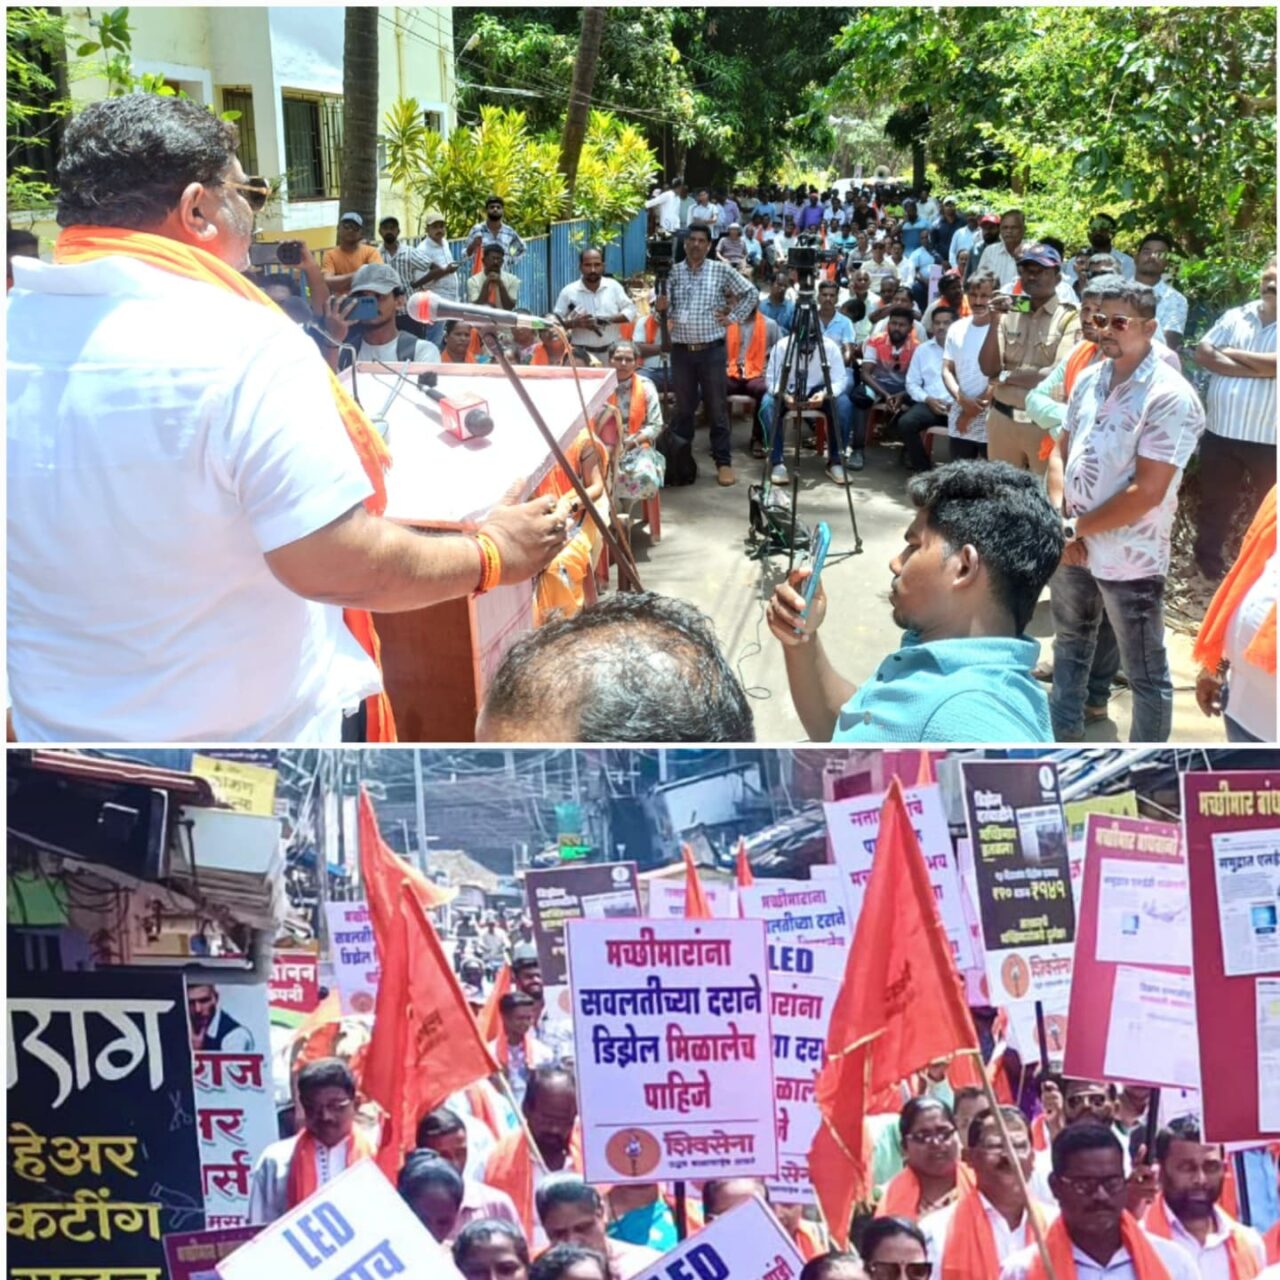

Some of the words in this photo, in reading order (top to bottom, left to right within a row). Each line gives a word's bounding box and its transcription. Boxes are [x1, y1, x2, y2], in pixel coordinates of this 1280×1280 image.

[607, 926, 731, 969] मच्छीमारांना
[768, 945, 814, 974] LED
[581, 976, 701, 1017] सवलतीच्या
[707, 973, 762, 1016] दराने
[7, 998, 176, 1109] राग
[593, 1024, 659, 1068] डिझेल
[666, 1021, 756, 1063] मिळालेच
[643, 1070, 712, 1113] पाहिजे
[8, 1133, 139, 1183] हेअर
[663, 1129, 755, 1157] शिवसेना
[6, 1187, 162, 1242] कटींग
[282, 1200, 356, 1271] LED
